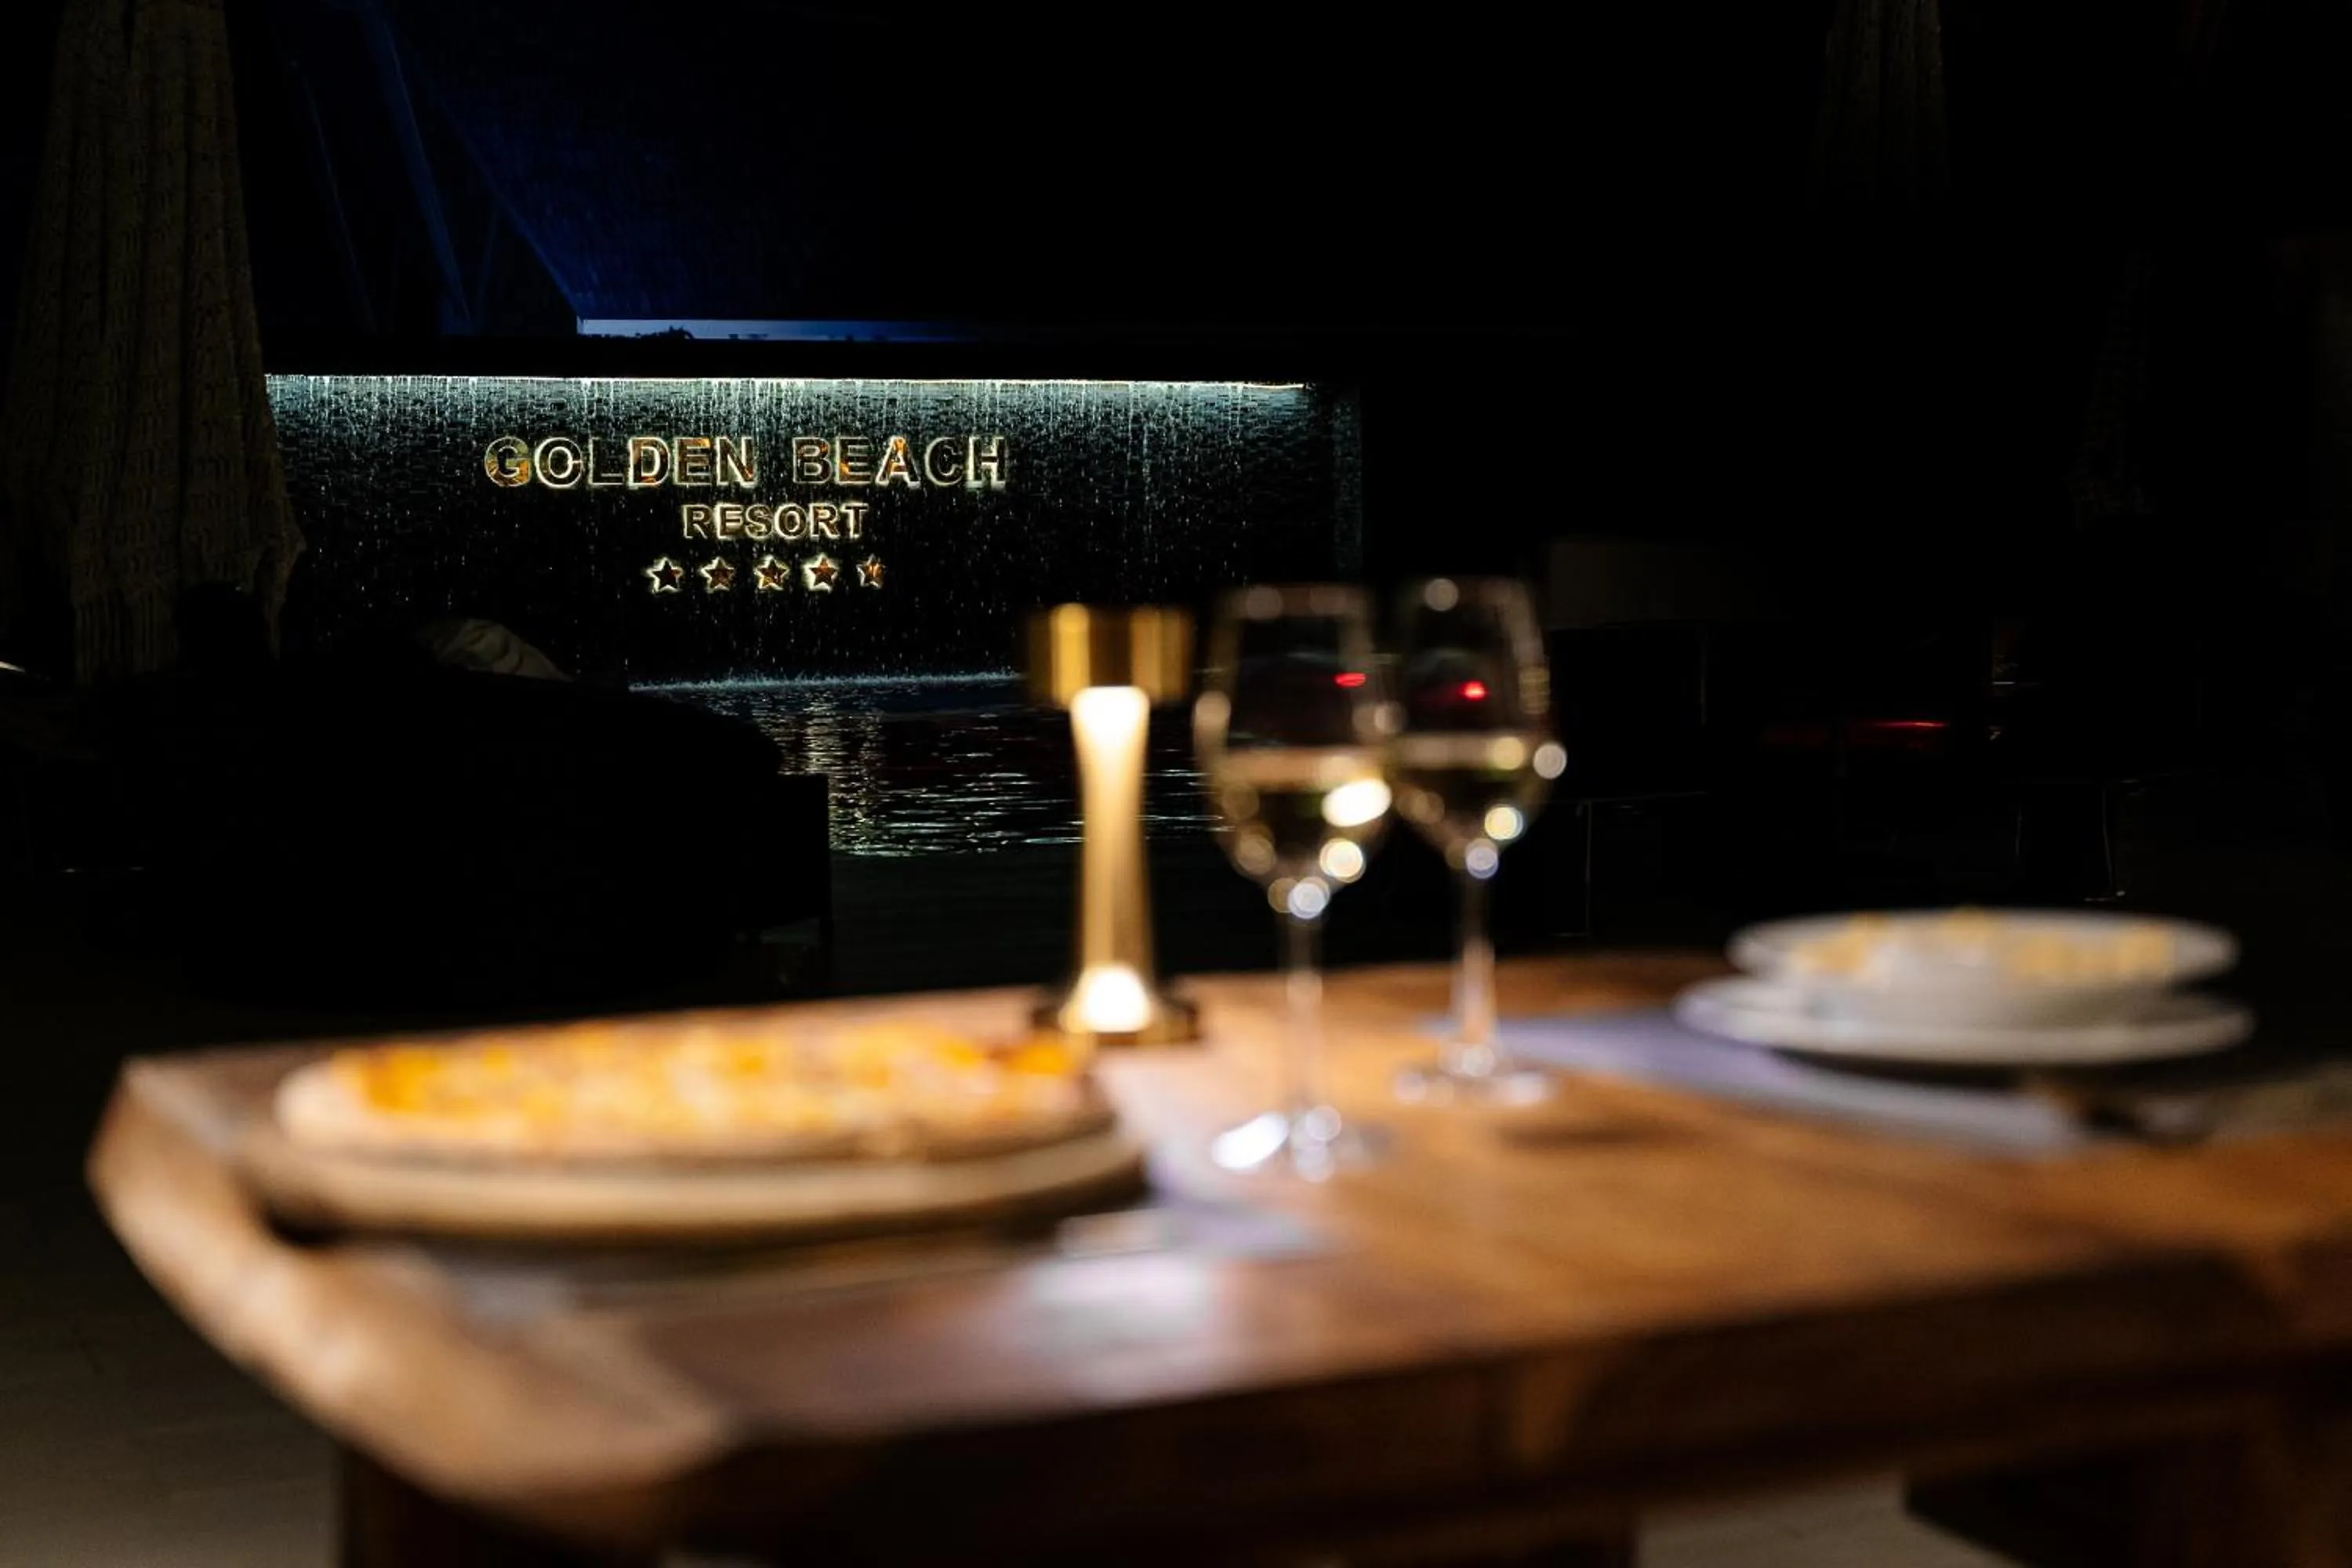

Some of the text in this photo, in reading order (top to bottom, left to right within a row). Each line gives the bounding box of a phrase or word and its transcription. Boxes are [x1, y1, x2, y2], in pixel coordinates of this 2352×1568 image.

[484, 436, 1007, 488] GOLDEN BEACH
[681, 502, 869, 539] RESORT
